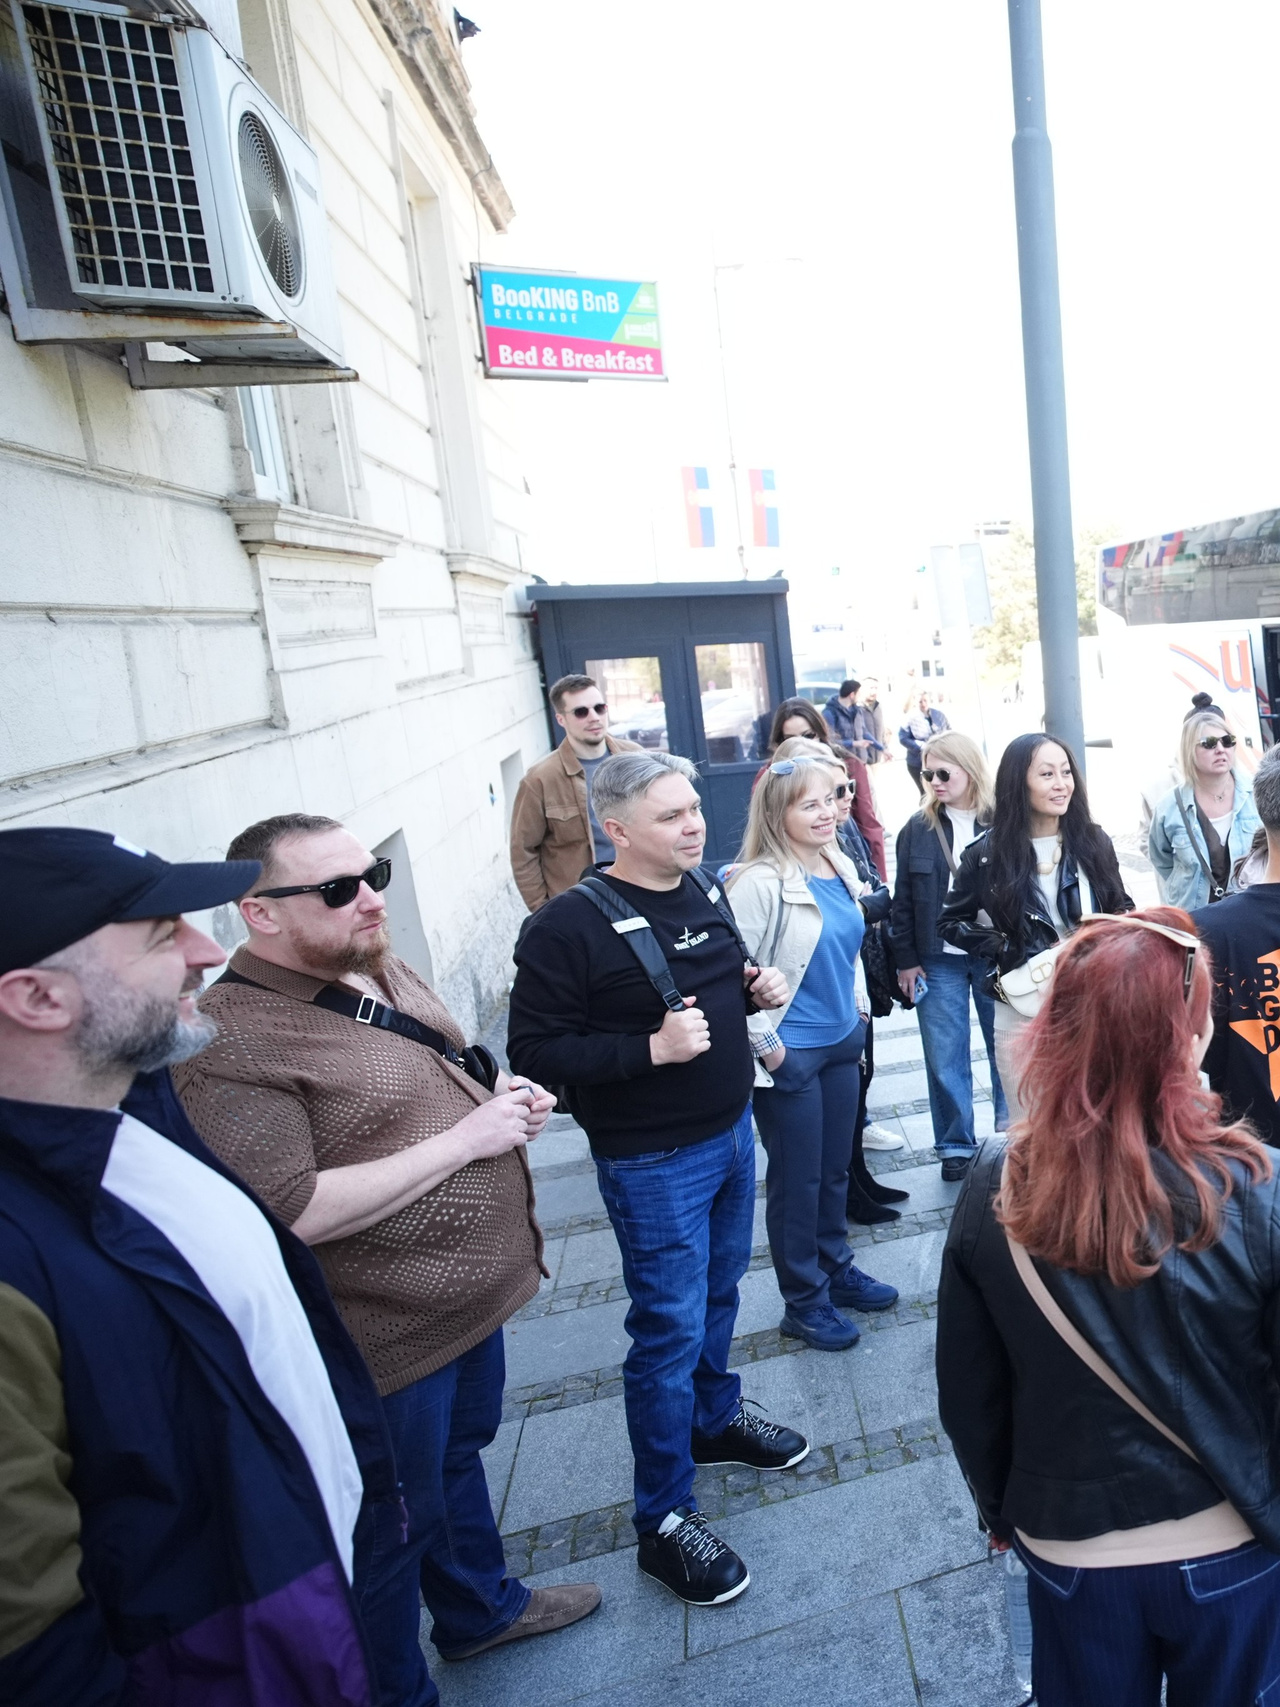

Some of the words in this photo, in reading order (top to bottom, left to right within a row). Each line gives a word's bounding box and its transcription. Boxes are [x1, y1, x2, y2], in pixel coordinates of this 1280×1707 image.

[582, 289, 620, 313] BnB
[494, 308, 577, 323] BELGRADE
[498, 344, 538, 367] Bed
[542, 347, 558, 368] &
[561, 348, 654, 372] Breakfast
